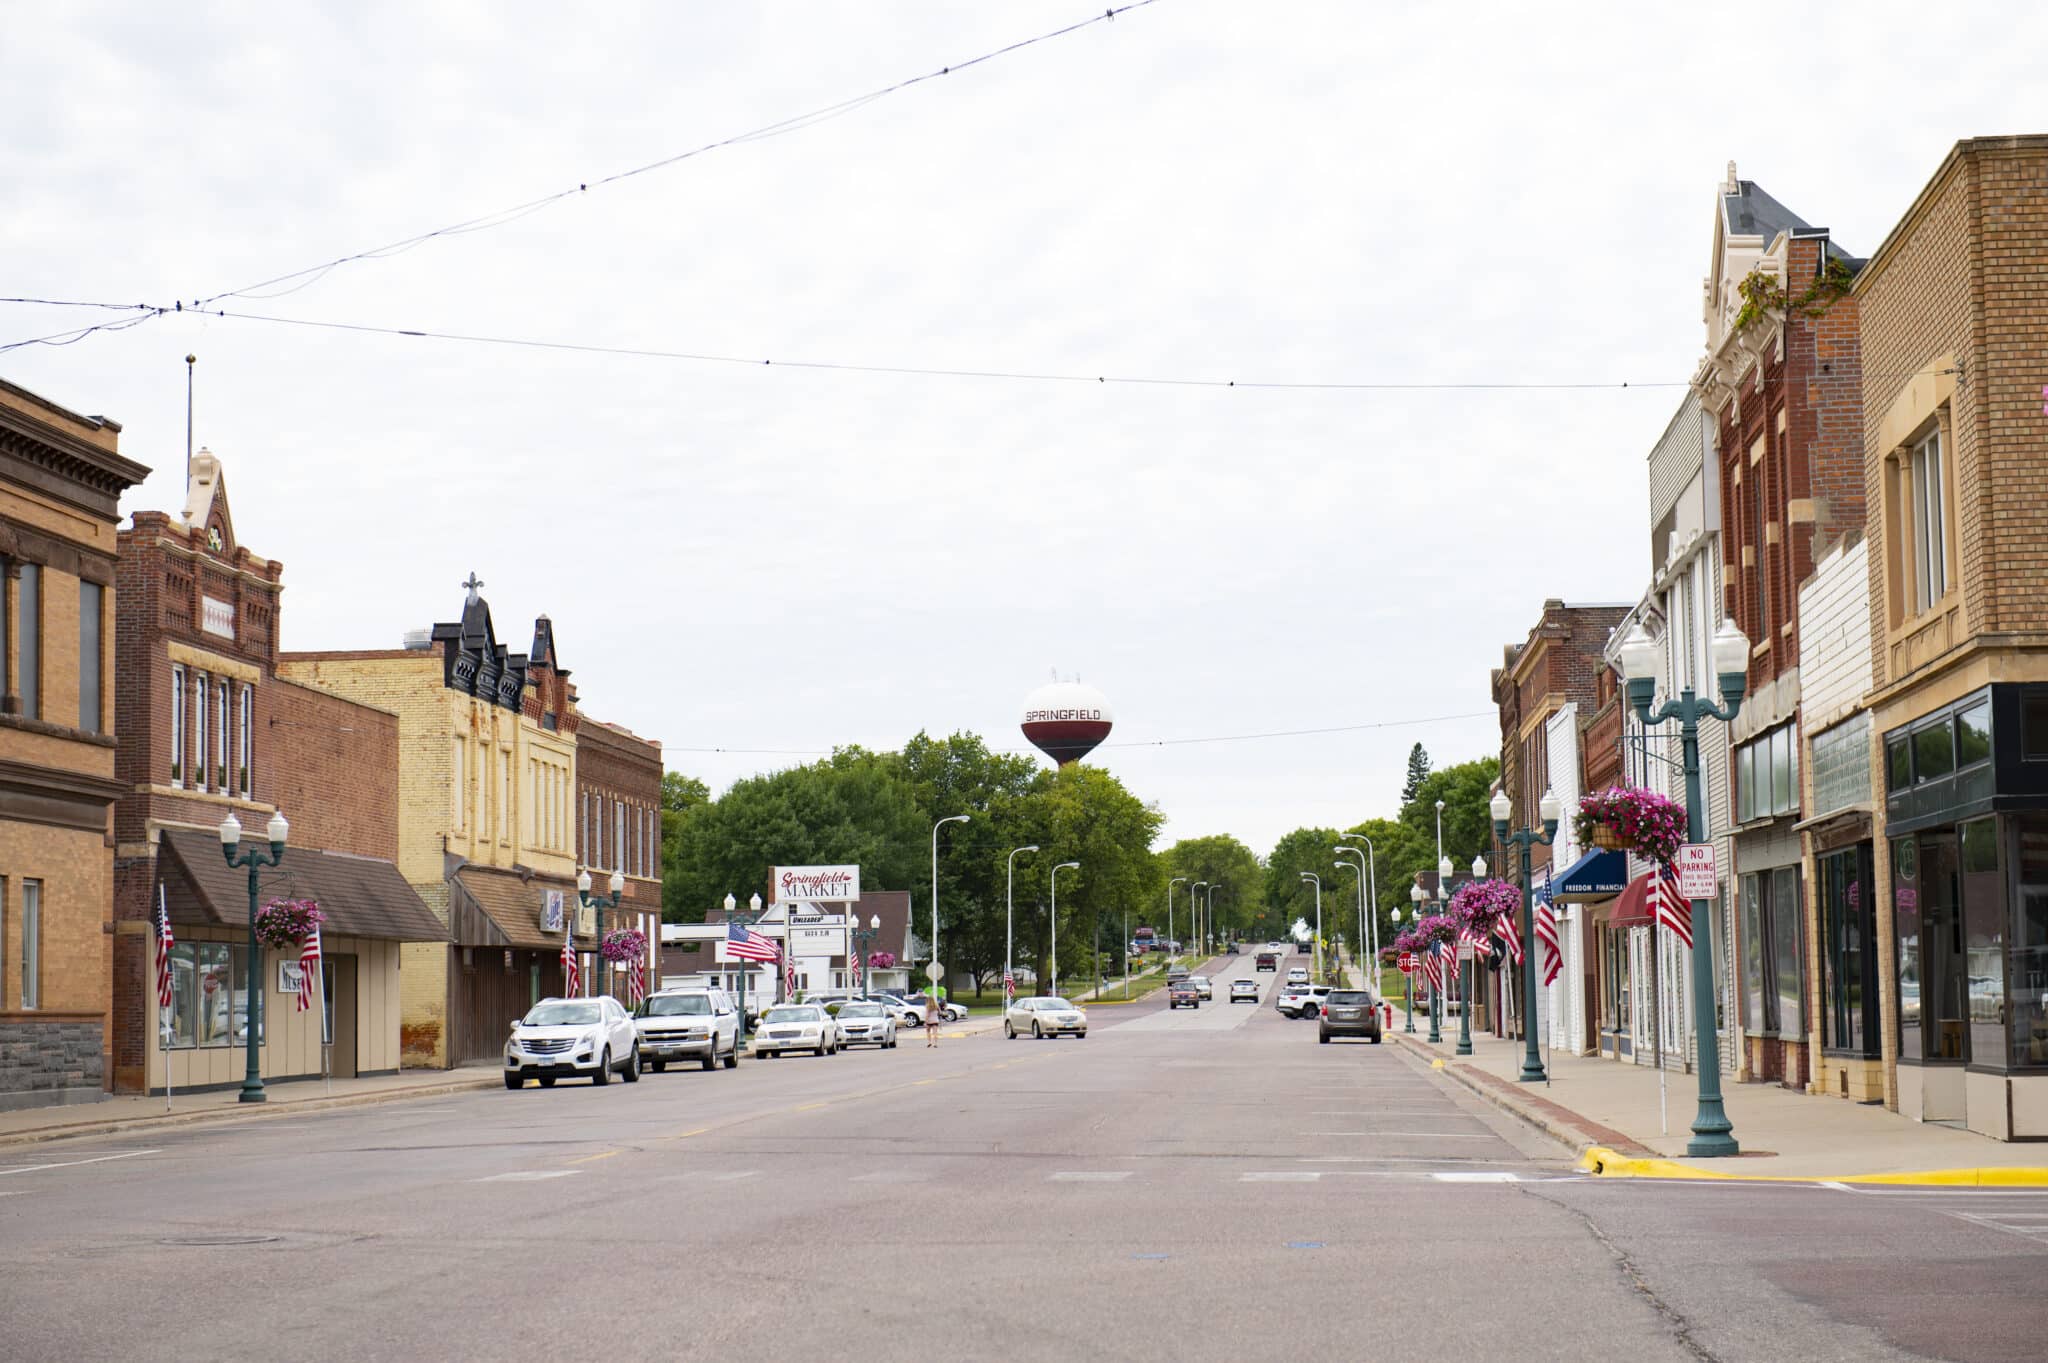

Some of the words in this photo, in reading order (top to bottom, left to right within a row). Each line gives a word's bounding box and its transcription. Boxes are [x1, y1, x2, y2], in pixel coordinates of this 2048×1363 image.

[1026, 709, 1101, 722] SPRINGFIELD
[1690, 849, 1704, 859] NO
[1681, 862, 1714, 872] PARKING
[781, 872, 845, 888] Springfield
[784, 882, 851, 897] MARKET
[1565, 884, 1592, 892] FREEDOM
[1398, 958, 1412, 967] STO
